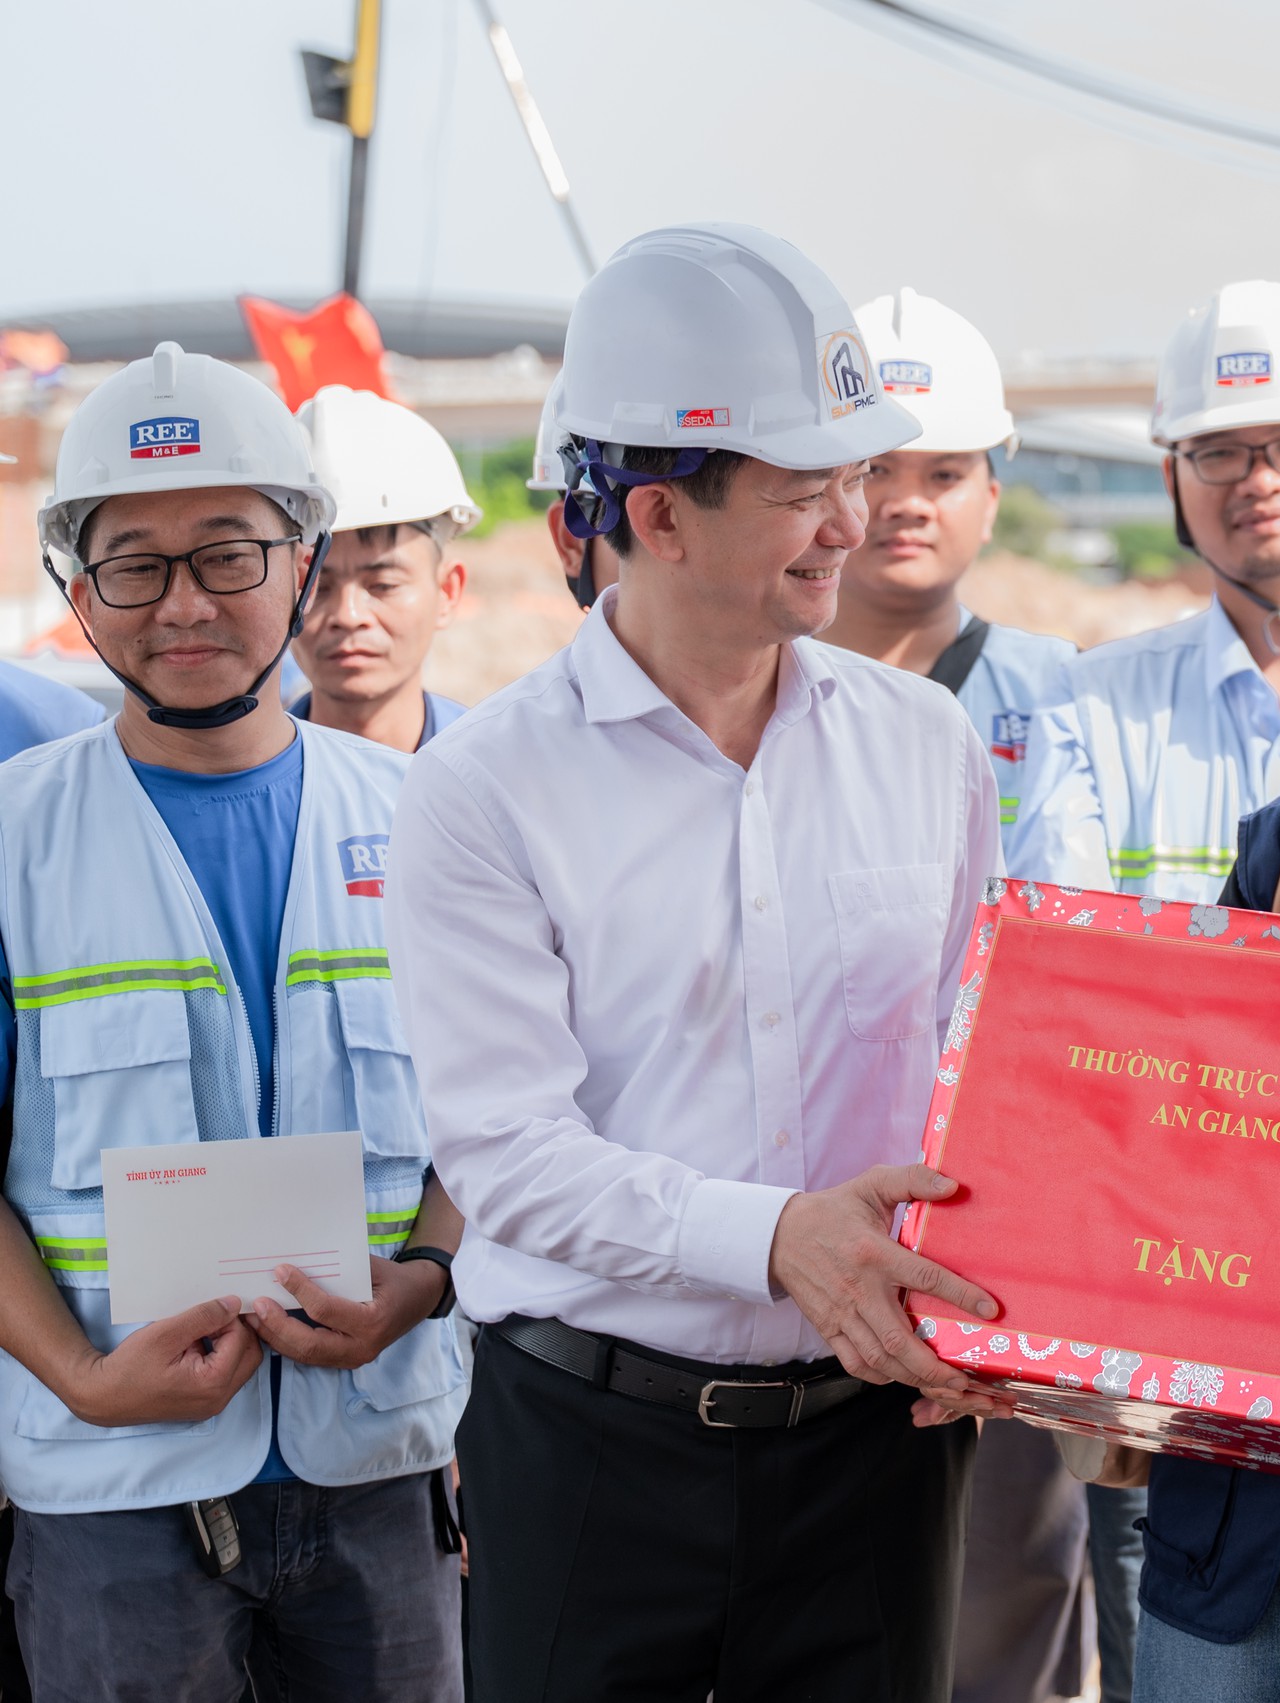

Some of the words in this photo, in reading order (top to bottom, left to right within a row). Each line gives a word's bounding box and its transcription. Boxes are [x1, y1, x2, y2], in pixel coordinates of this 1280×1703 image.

[1221, 355, 1267, 375] REE
[136, 422, 192, 444] REE
[347, 844, 388, 873] RE
[1067, 1045, 1191, 1084] THƯỜNG
[1197, 1064, 1279, 1099] TRỰC
[1149, 1102, 1193, 1129] AN
[163, 1169, 176, 1178] AN
[177, 1167, 207, 1177] GIANG
[1133, 1237, 1252, 1288] TẶNG
